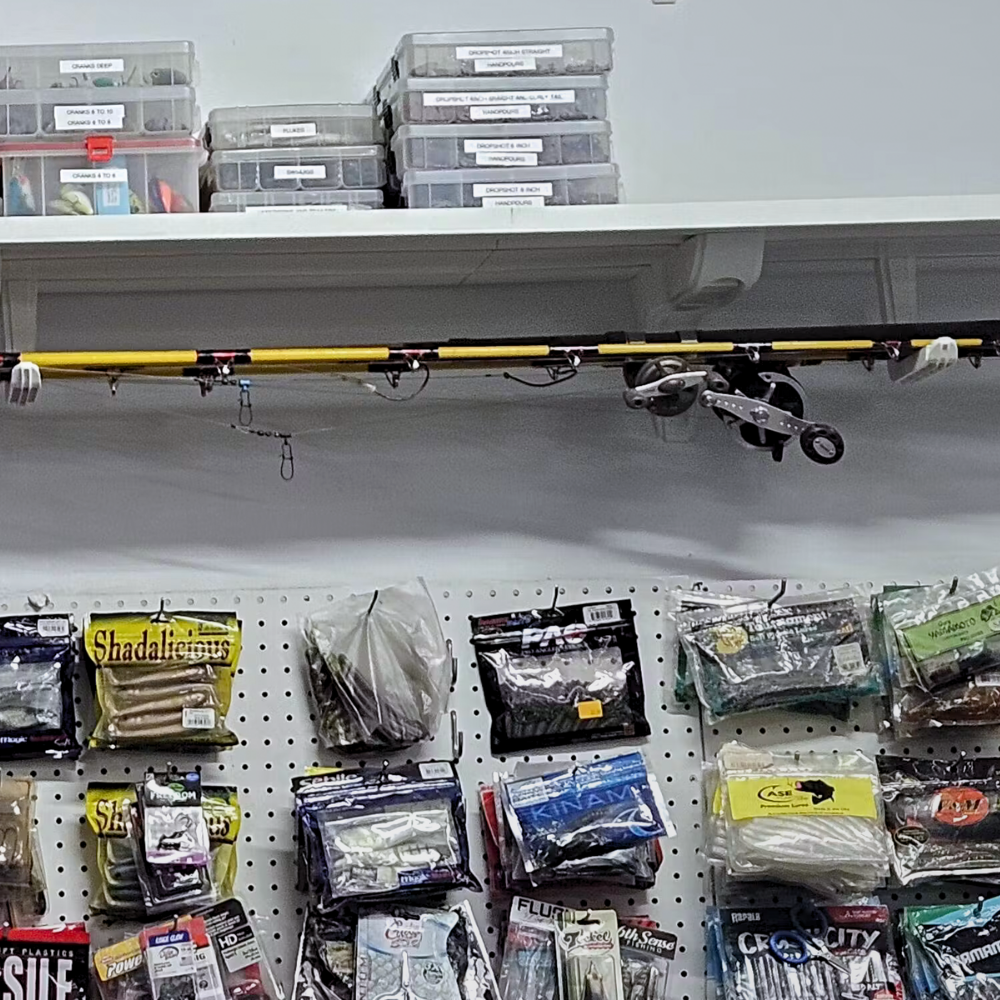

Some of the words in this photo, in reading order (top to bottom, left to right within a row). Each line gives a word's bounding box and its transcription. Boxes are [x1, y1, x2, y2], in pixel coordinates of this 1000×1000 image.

[94, 629, 230, 662] Shadalicious
[531, 783, 638, 822] KINAM
[218, 934, 238, 948] HD
[640, 931, 675, 951] Sense
[826, 927, 880, 950] CITY
[22, 948, 74, 958] PLASTICS
